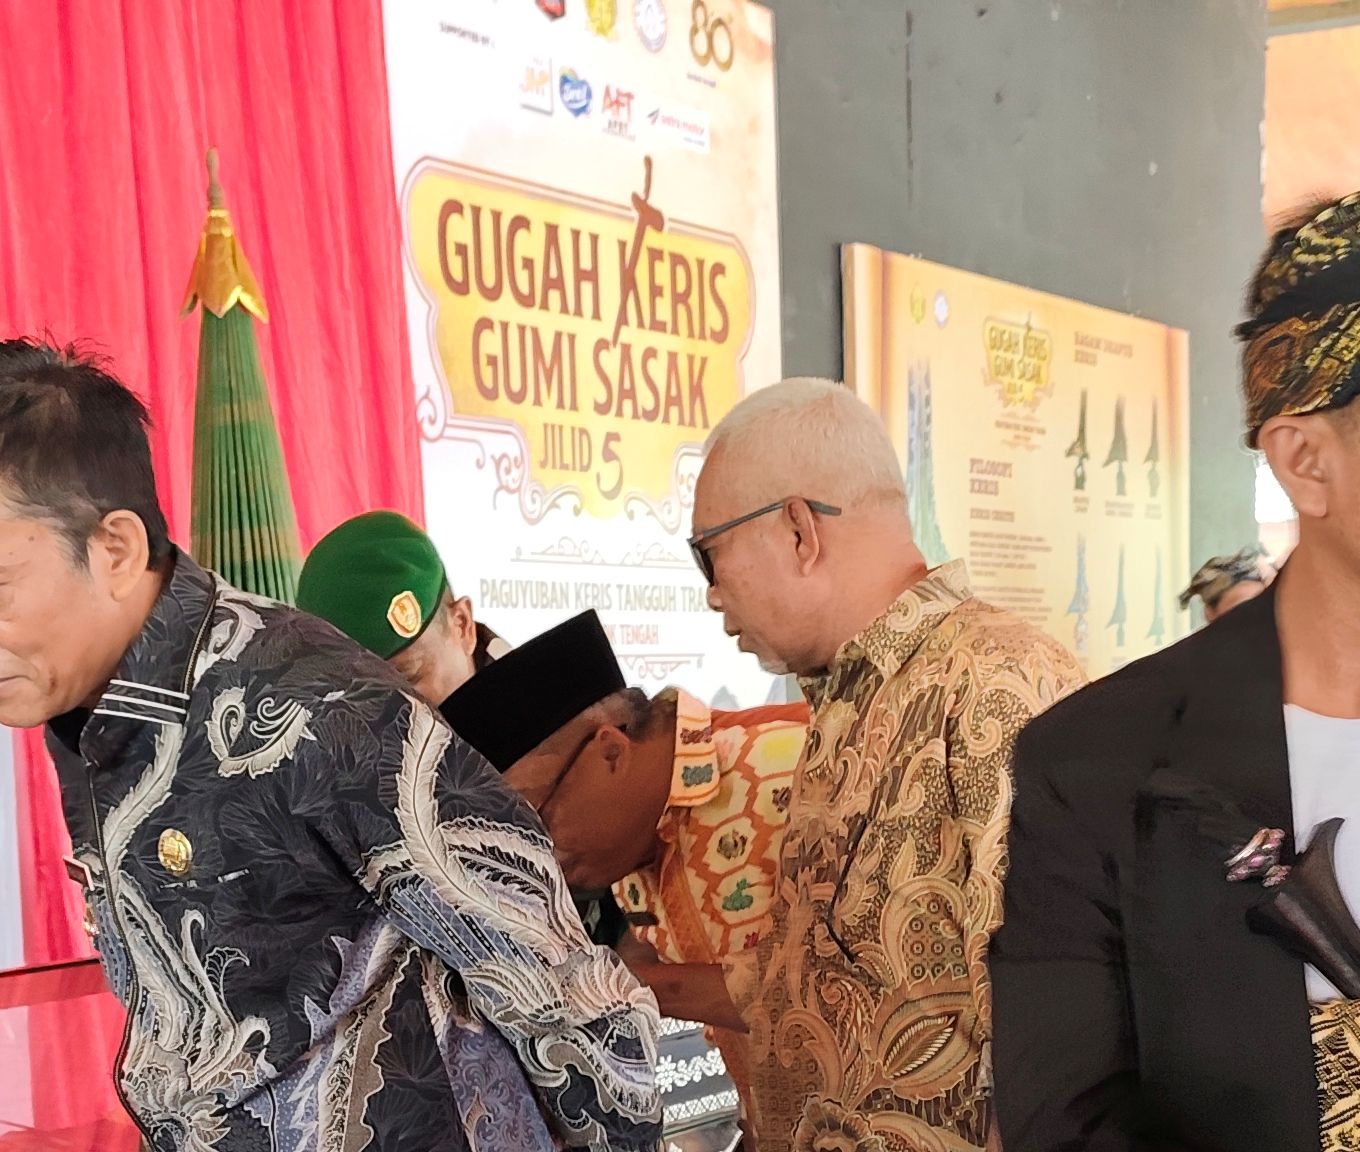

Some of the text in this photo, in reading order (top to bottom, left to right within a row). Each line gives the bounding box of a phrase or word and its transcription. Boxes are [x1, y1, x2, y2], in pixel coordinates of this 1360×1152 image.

[437, 199, 731, 345] GUGAH KERIS
[471, 316, 710, 429] GUMI SASAK
[539, 423, 623, 500] JILID 5
[479, 578, 710, 613] PAGUYUBAN KERIS TANGGUH TRA
[620, 624, 659, 645] TENGAH
